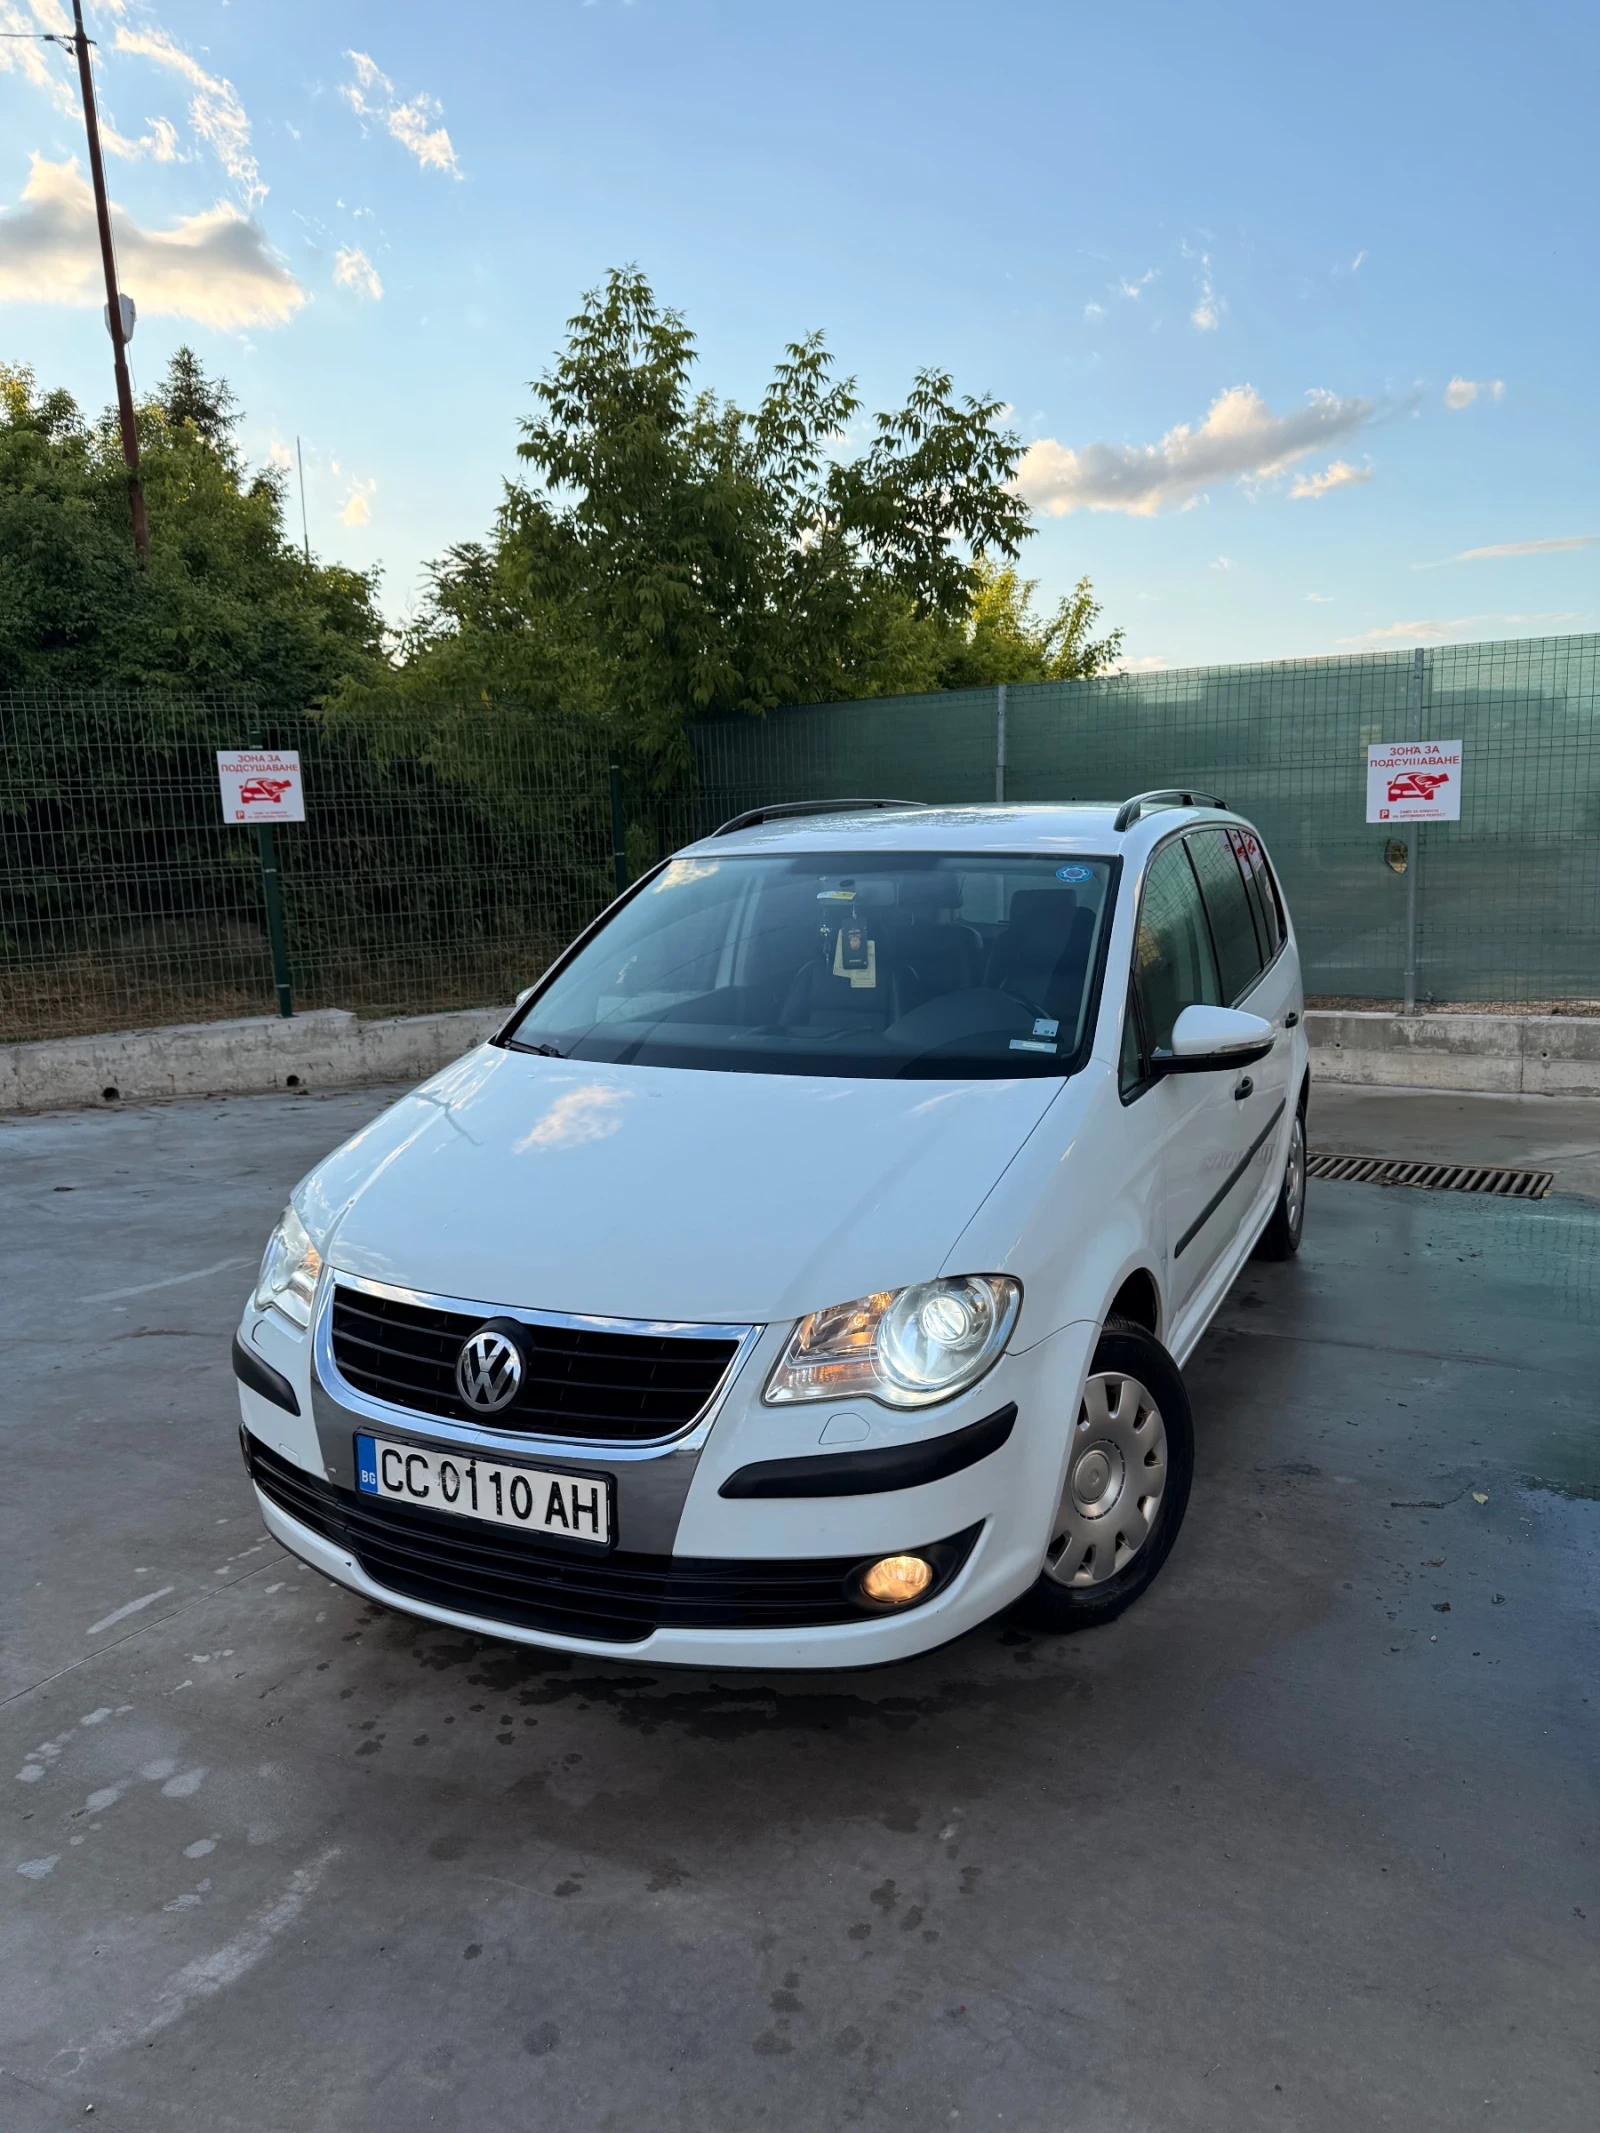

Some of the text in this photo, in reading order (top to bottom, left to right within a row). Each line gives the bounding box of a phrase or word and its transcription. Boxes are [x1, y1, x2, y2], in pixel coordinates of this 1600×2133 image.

[1390, 745, 1440, 756] ЗОНА ЗА
[237, 754, 281, 762] ЗОНА ЗА
[1370, 755, 1460, 768] ПОДСУШАВАНЕ
[221, 763, 299, 773] ПОДСУШАВАНЕ
[457, 1331, 521, 1412] VW
[361, 1470, 377, 1485] BG
[381, 1448, 599, 1534] CC 0110 AH
